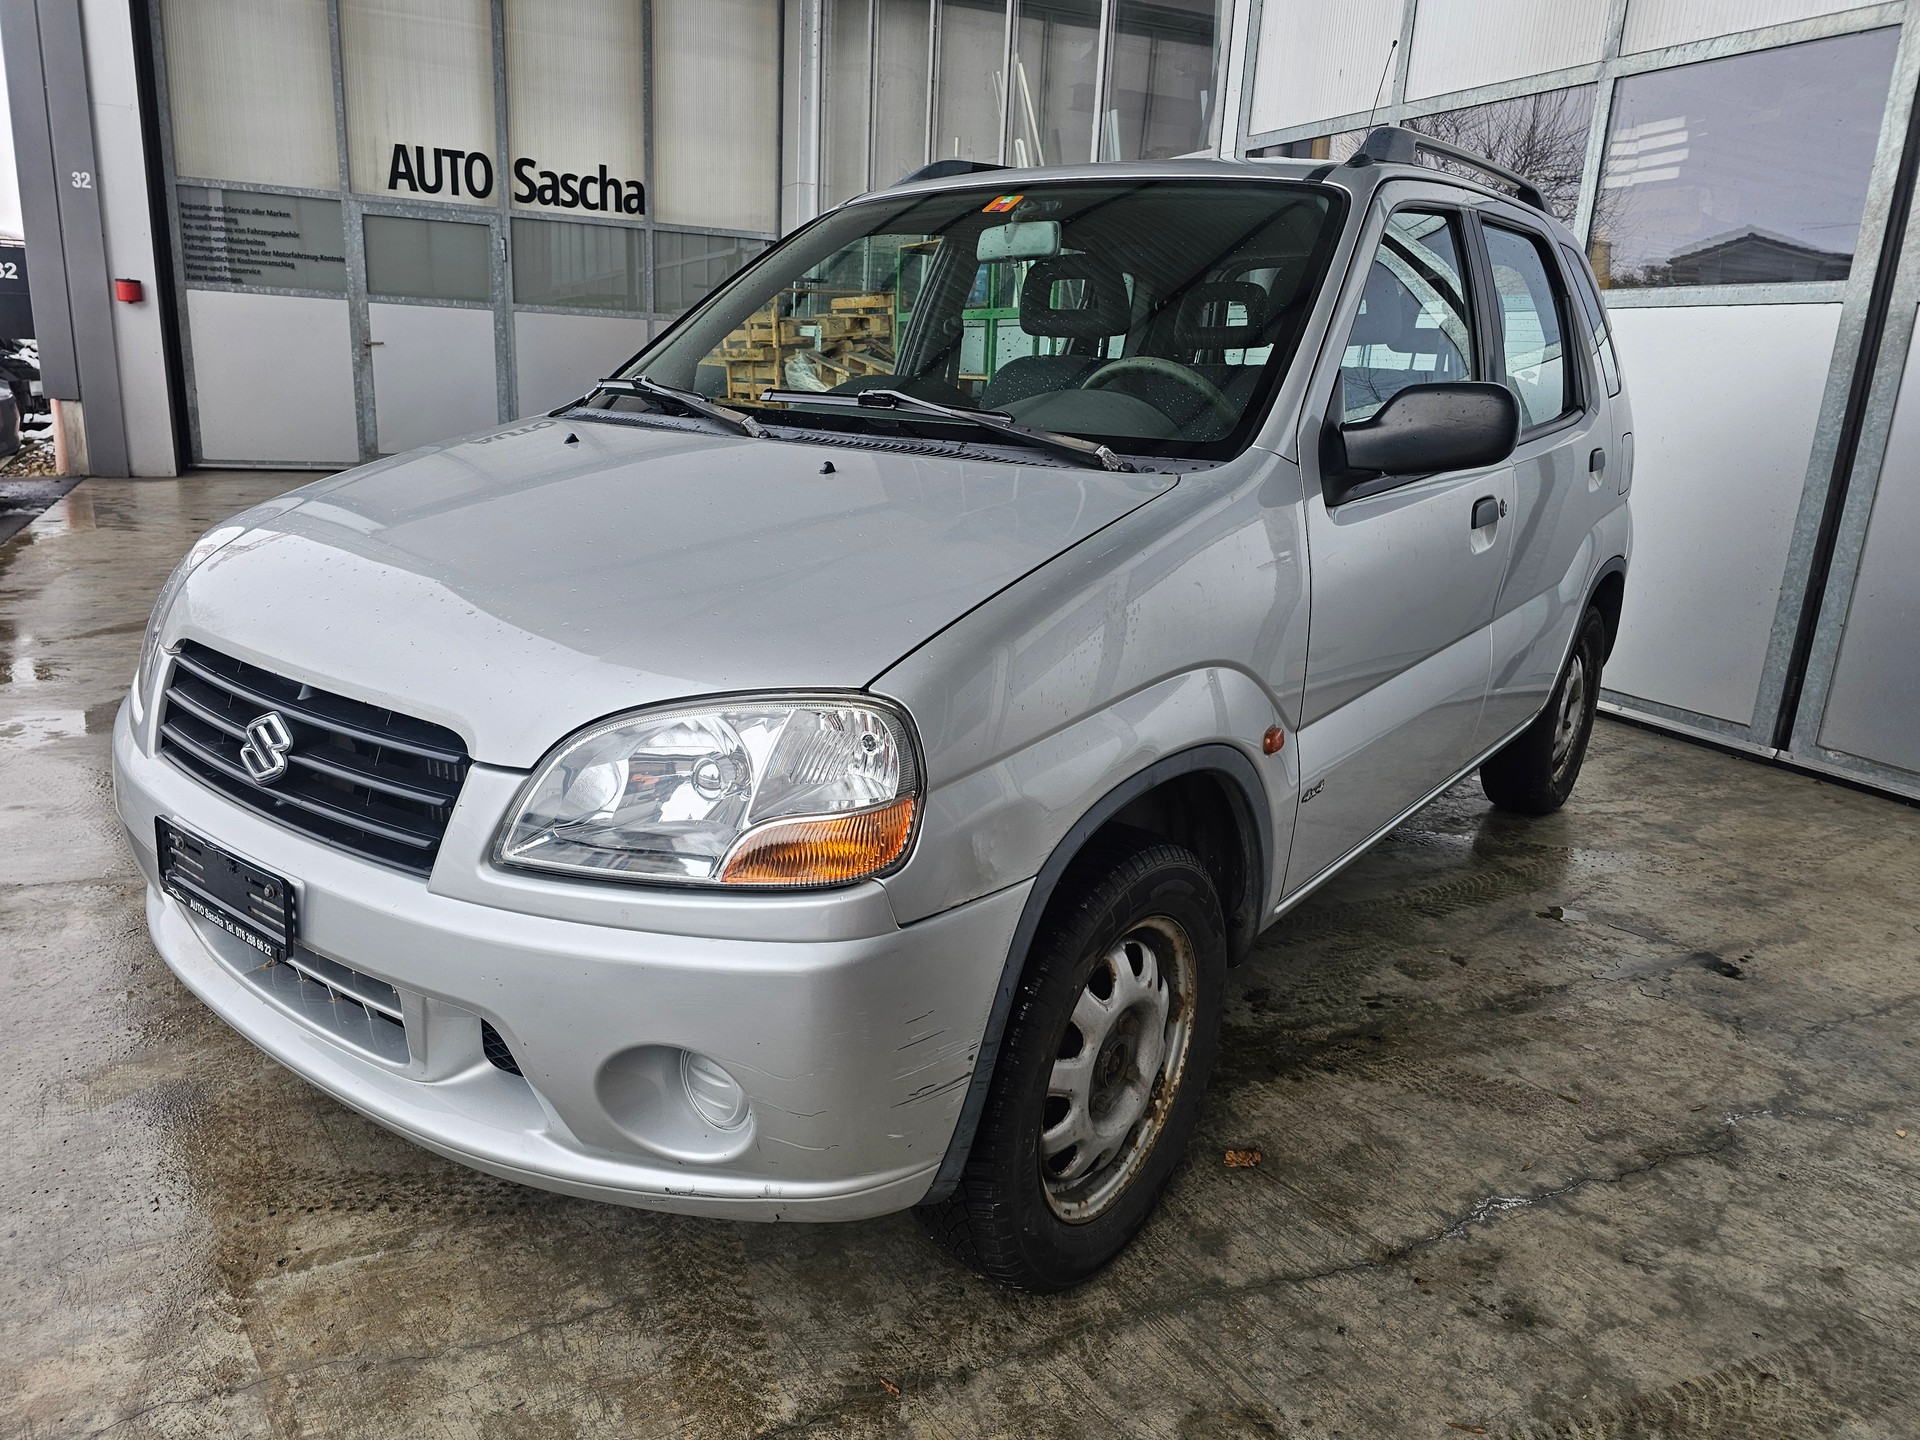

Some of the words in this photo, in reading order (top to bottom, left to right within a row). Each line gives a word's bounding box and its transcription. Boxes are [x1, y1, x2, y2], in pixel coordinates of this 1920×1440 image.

[71, 171, 92, 189] 32
[388, 143, 493, 199] AUTO
[513, 157, 645, 215] Sascha
[180, 202, 213, 211] Reparatur
[213, 205, 227, 213] und
[227, 206, 251, 215] Service
[251, 207, 266, 215] aller
[266, 209, 291, 218] Marken
[181, 212, 238, 225] Autoaufbereitung
[246, 227, 300, 238] Fahrzeugzubehör
[184, 243, 249, 256] Fahrzeugvorführung
[185, 253, 236, 263] Unverbindlicher
[237, 257, 295, 270] Kostenvoranschlag
[223, 265, 262, 275] Pneuservice
[187, 273, 203, 281] Faire
[204, 274, 243, 284] Konditionen
[190, 899, 205, 915] AUTO
[204, 908, 224, 928] Sascha
[225, 920, 235, 934] Tel.
